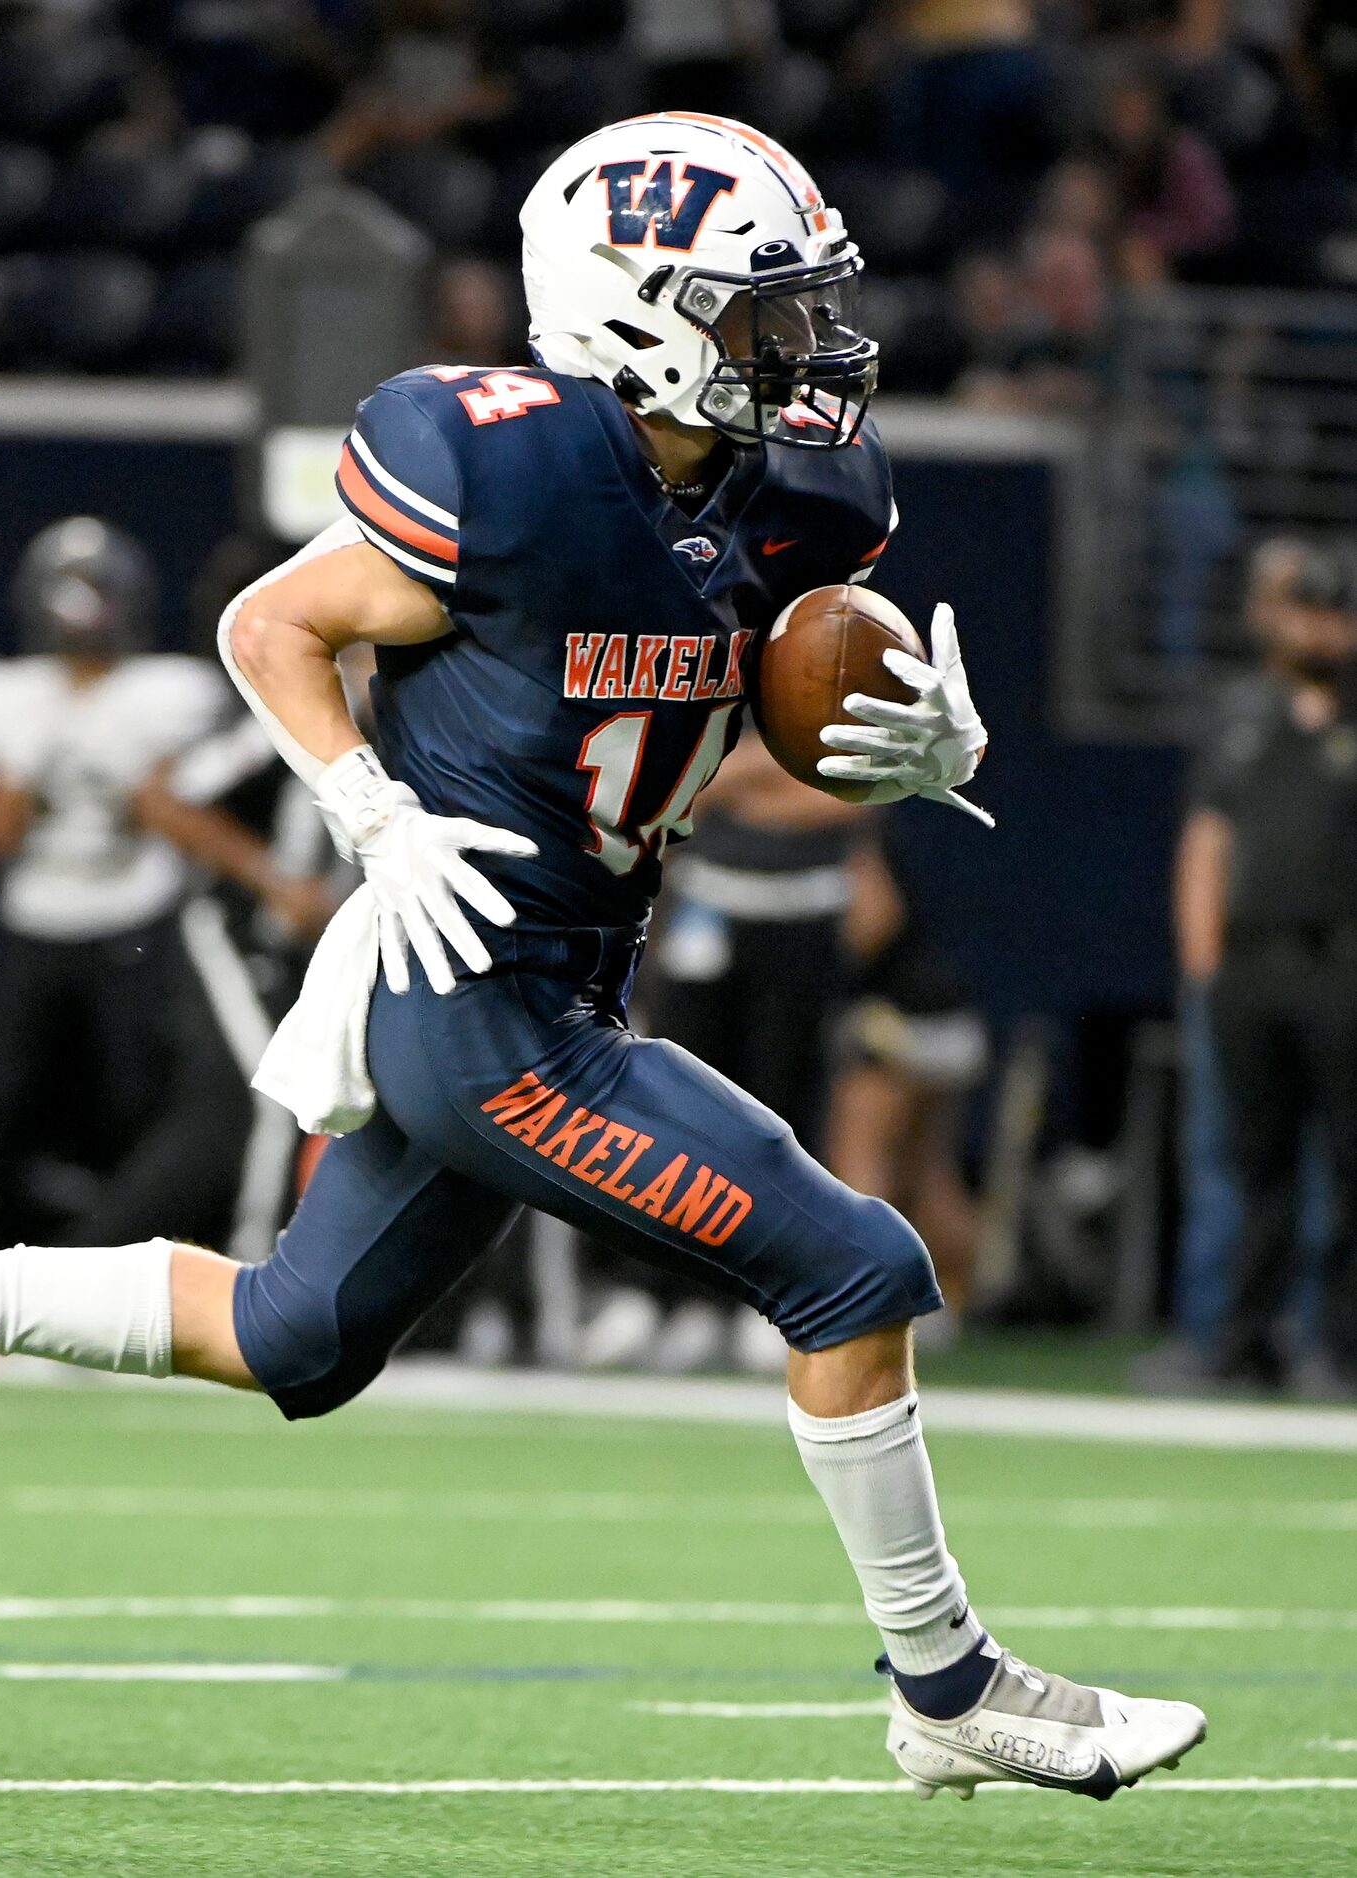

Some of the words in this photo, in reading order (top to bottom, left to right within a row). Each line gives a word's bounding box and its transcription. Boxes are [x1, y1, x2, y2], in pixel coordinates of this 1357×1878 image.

[595, 159, 739, 253] W
[563, 629, 755, 702] WAKELA
[479, 1071, 754, 1247] WAKELAND
